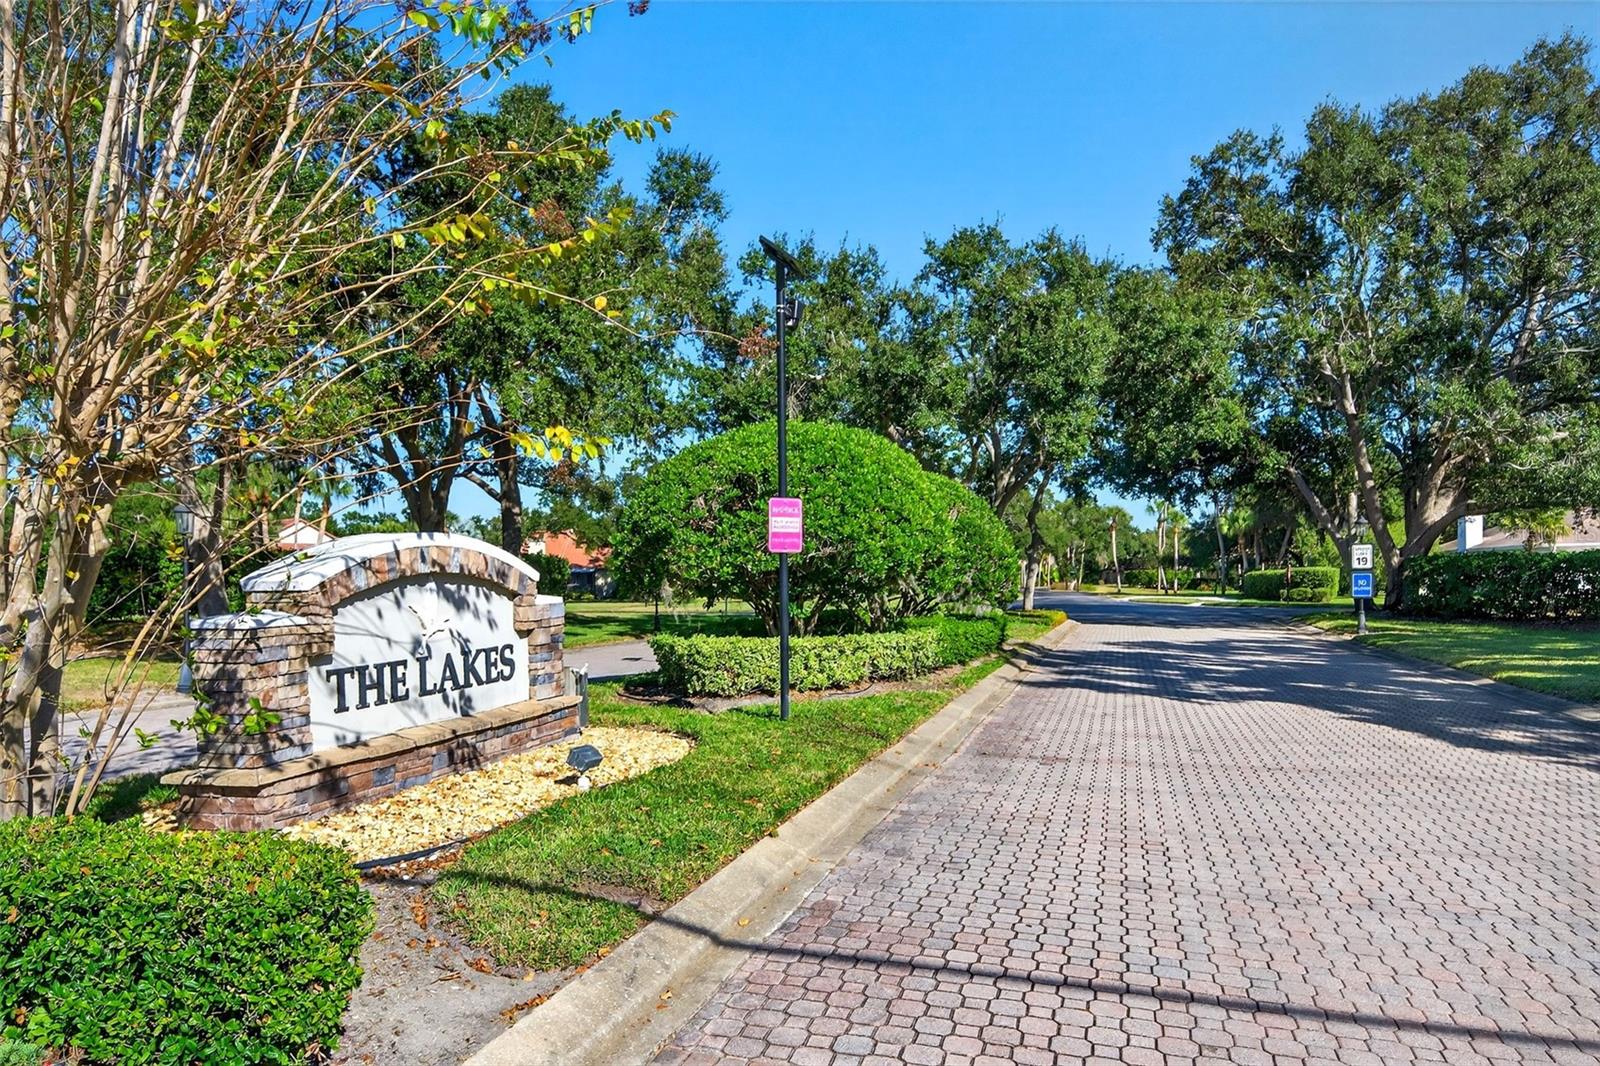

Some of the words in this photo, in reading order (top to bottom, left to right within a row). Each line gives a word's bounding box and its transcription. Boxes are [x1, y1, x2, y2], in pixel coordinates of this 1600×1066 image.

[1356, 556, 1368, 566] 19
[325, 659, 410, 714] THE
[415, 643, 516, 698] LAKES
